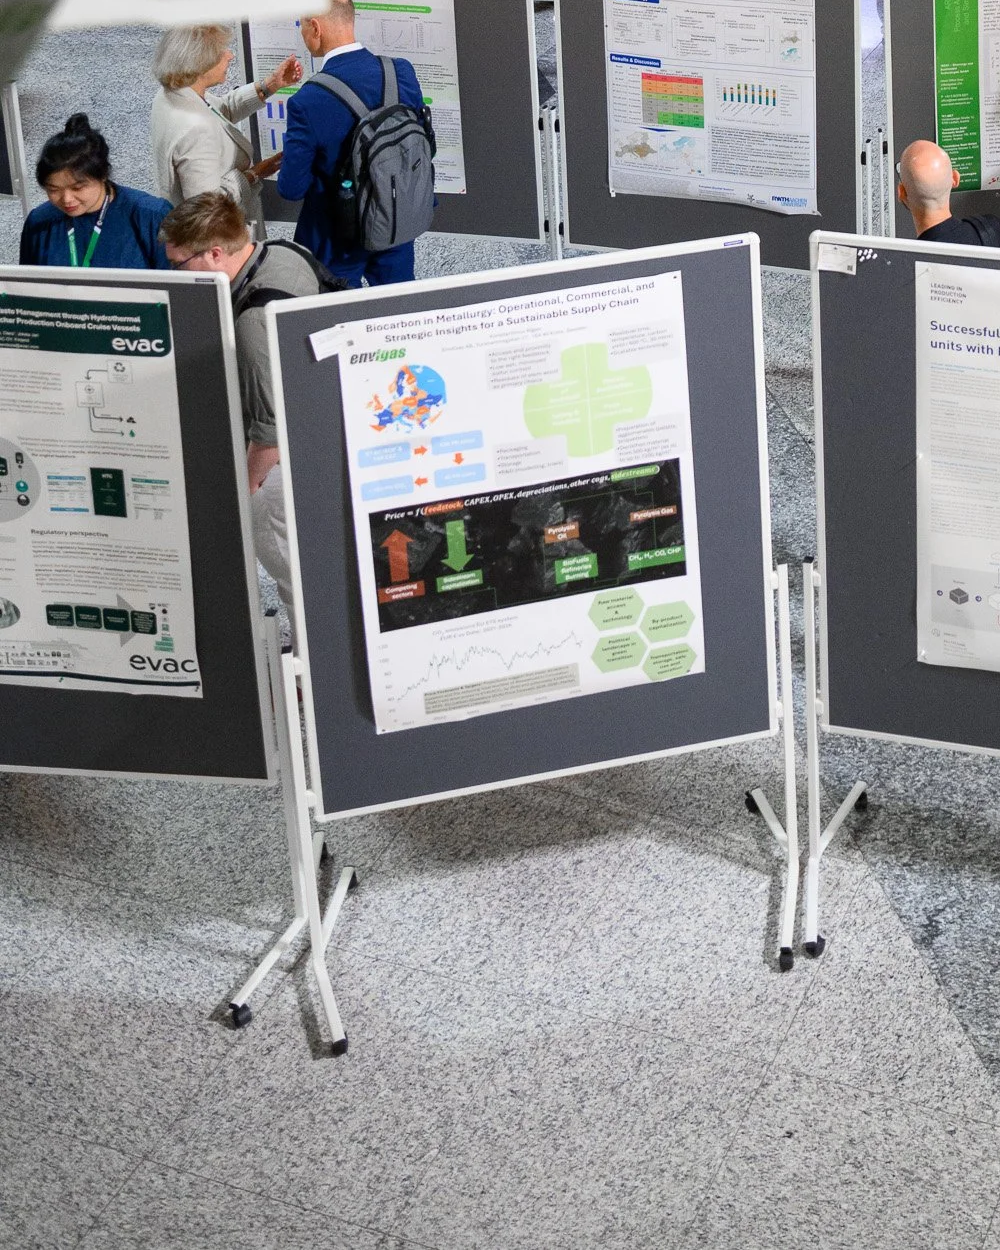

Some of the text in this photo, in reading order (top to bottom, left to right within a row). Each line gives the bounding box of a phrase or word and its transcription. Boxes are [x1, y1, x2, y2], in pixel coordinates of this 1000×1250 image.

[634, 58, 660, 66] Discussion
[930, 290, 966, 298] PRODUCTION
[930, 296, 963, 304] EFFICIENCY
[366, 282, 655, 332] Biocarbon in Metallurgy: Operational, Commercial, and
[16, 309, 140, 323] Management through Hydrothermal
[385, 329, 432, 342] Strategic
[436, 324, 478, 336] Insights
[507, 309, 568, 325] Sustainable
[571, 302, 606, 314] Supply
[610, 297, 639, 307] Chain
[17, 318, 54, 327] Production
[56, 321, 86, 329] Onboard
[112, 324, 140, 332] Vessels
[930, 321, 1000, 338] Successful
[112, 337, 164, 352] evac
[930, 340, 962, 351] units
[966, 344, 994, 355] with
[350, 348, 406, 365] envigas
[385, 512, 405, 521] Price
[570, 478, 589, 487] other
[634, 510, 660, 519] Pyrolysis
[548, 524, 575, 534] Pyrolysis
[385, 583, 418, 594] Competing
[392, 591, 414, 599] sectors
[603, 615, 632, 623] technology
[130, 654, 198, 673] evac
